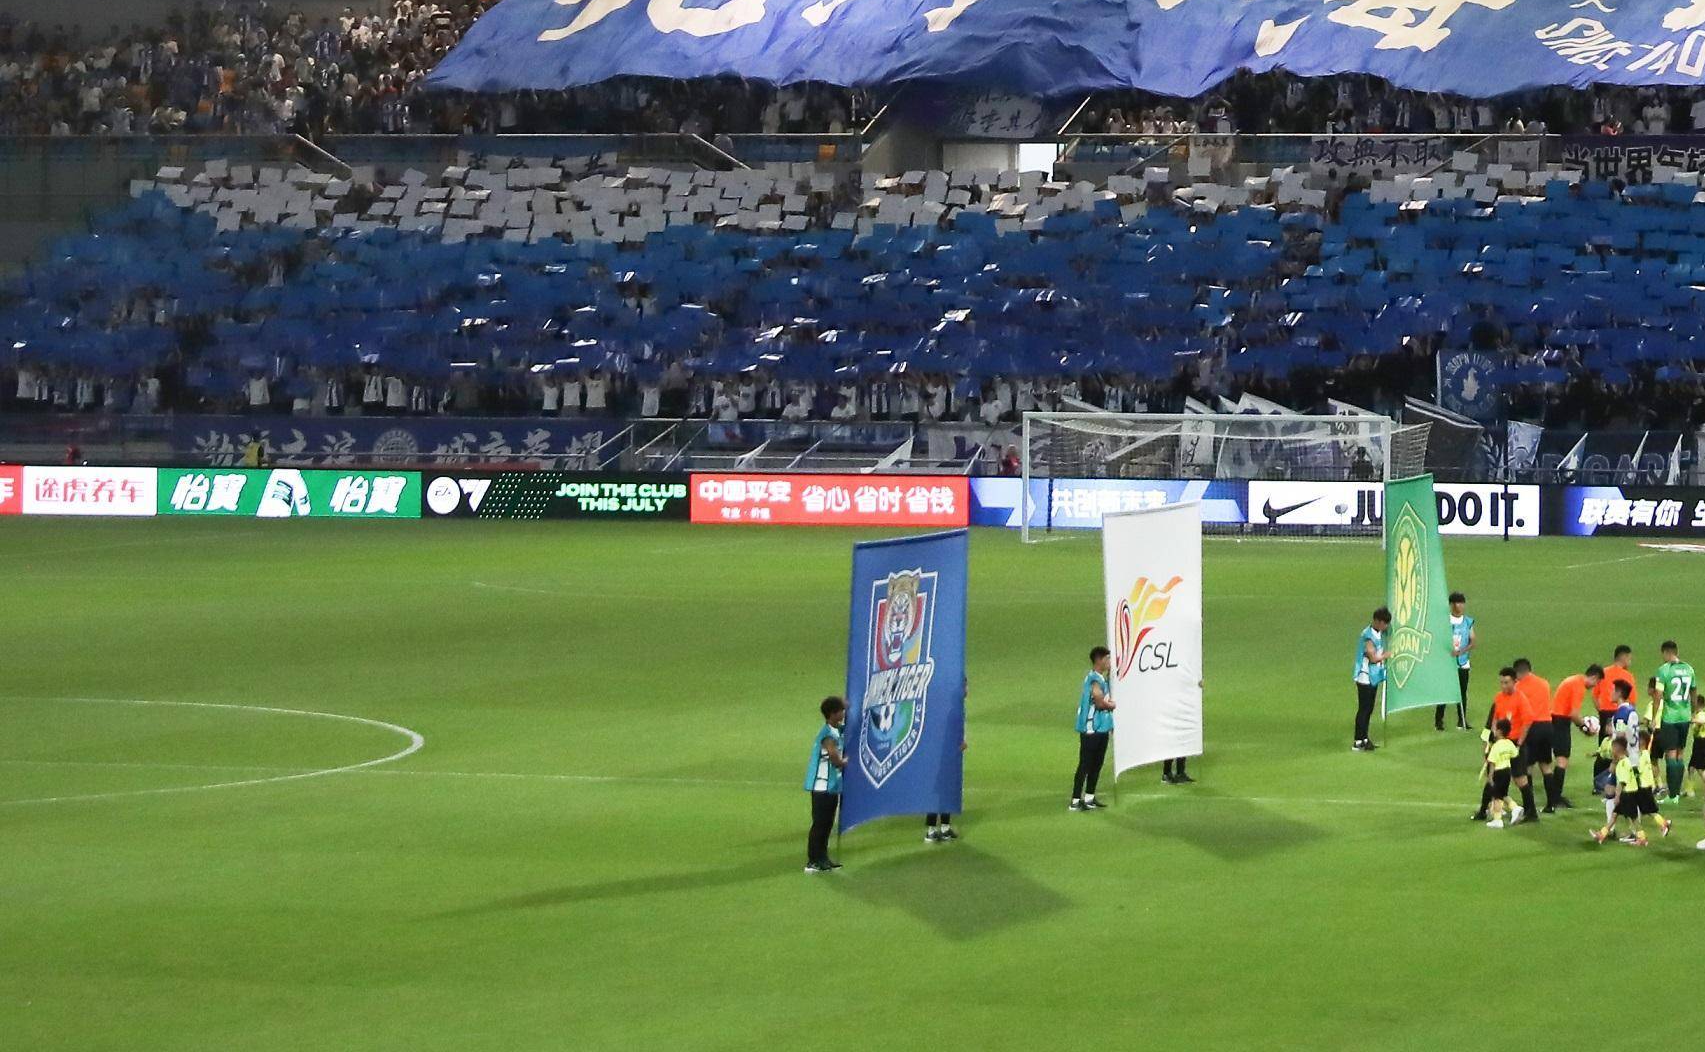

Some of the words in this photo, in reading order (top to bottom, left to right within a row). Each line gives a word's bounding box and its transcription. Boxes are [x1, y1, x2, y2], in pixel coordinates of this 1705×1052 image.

[35, 476, 145, 503] 途虎养车
[170, 473, 247, 511] 怡寶
[329, 475, 407, 514] 怡寶
[555, 483, 602, 498] JOIN
[603, 483, 638, 498] THE
[637, 484, 687, 499] CLUB
[698, 479, 792, 503] 中国平安
[801, 485, 850, 513] 省心
[853, 486, 902, 514] 省时
[905, 486, 956, 515] 省钱
[578, 498, 622, 512] THIS
[625, 498, 667, 512] JULY
[1578, 497, 1683, 528] 联赛有你
[1138, 642, 1178, 673] CSL
[1670, 677, 1692, 701] 27
